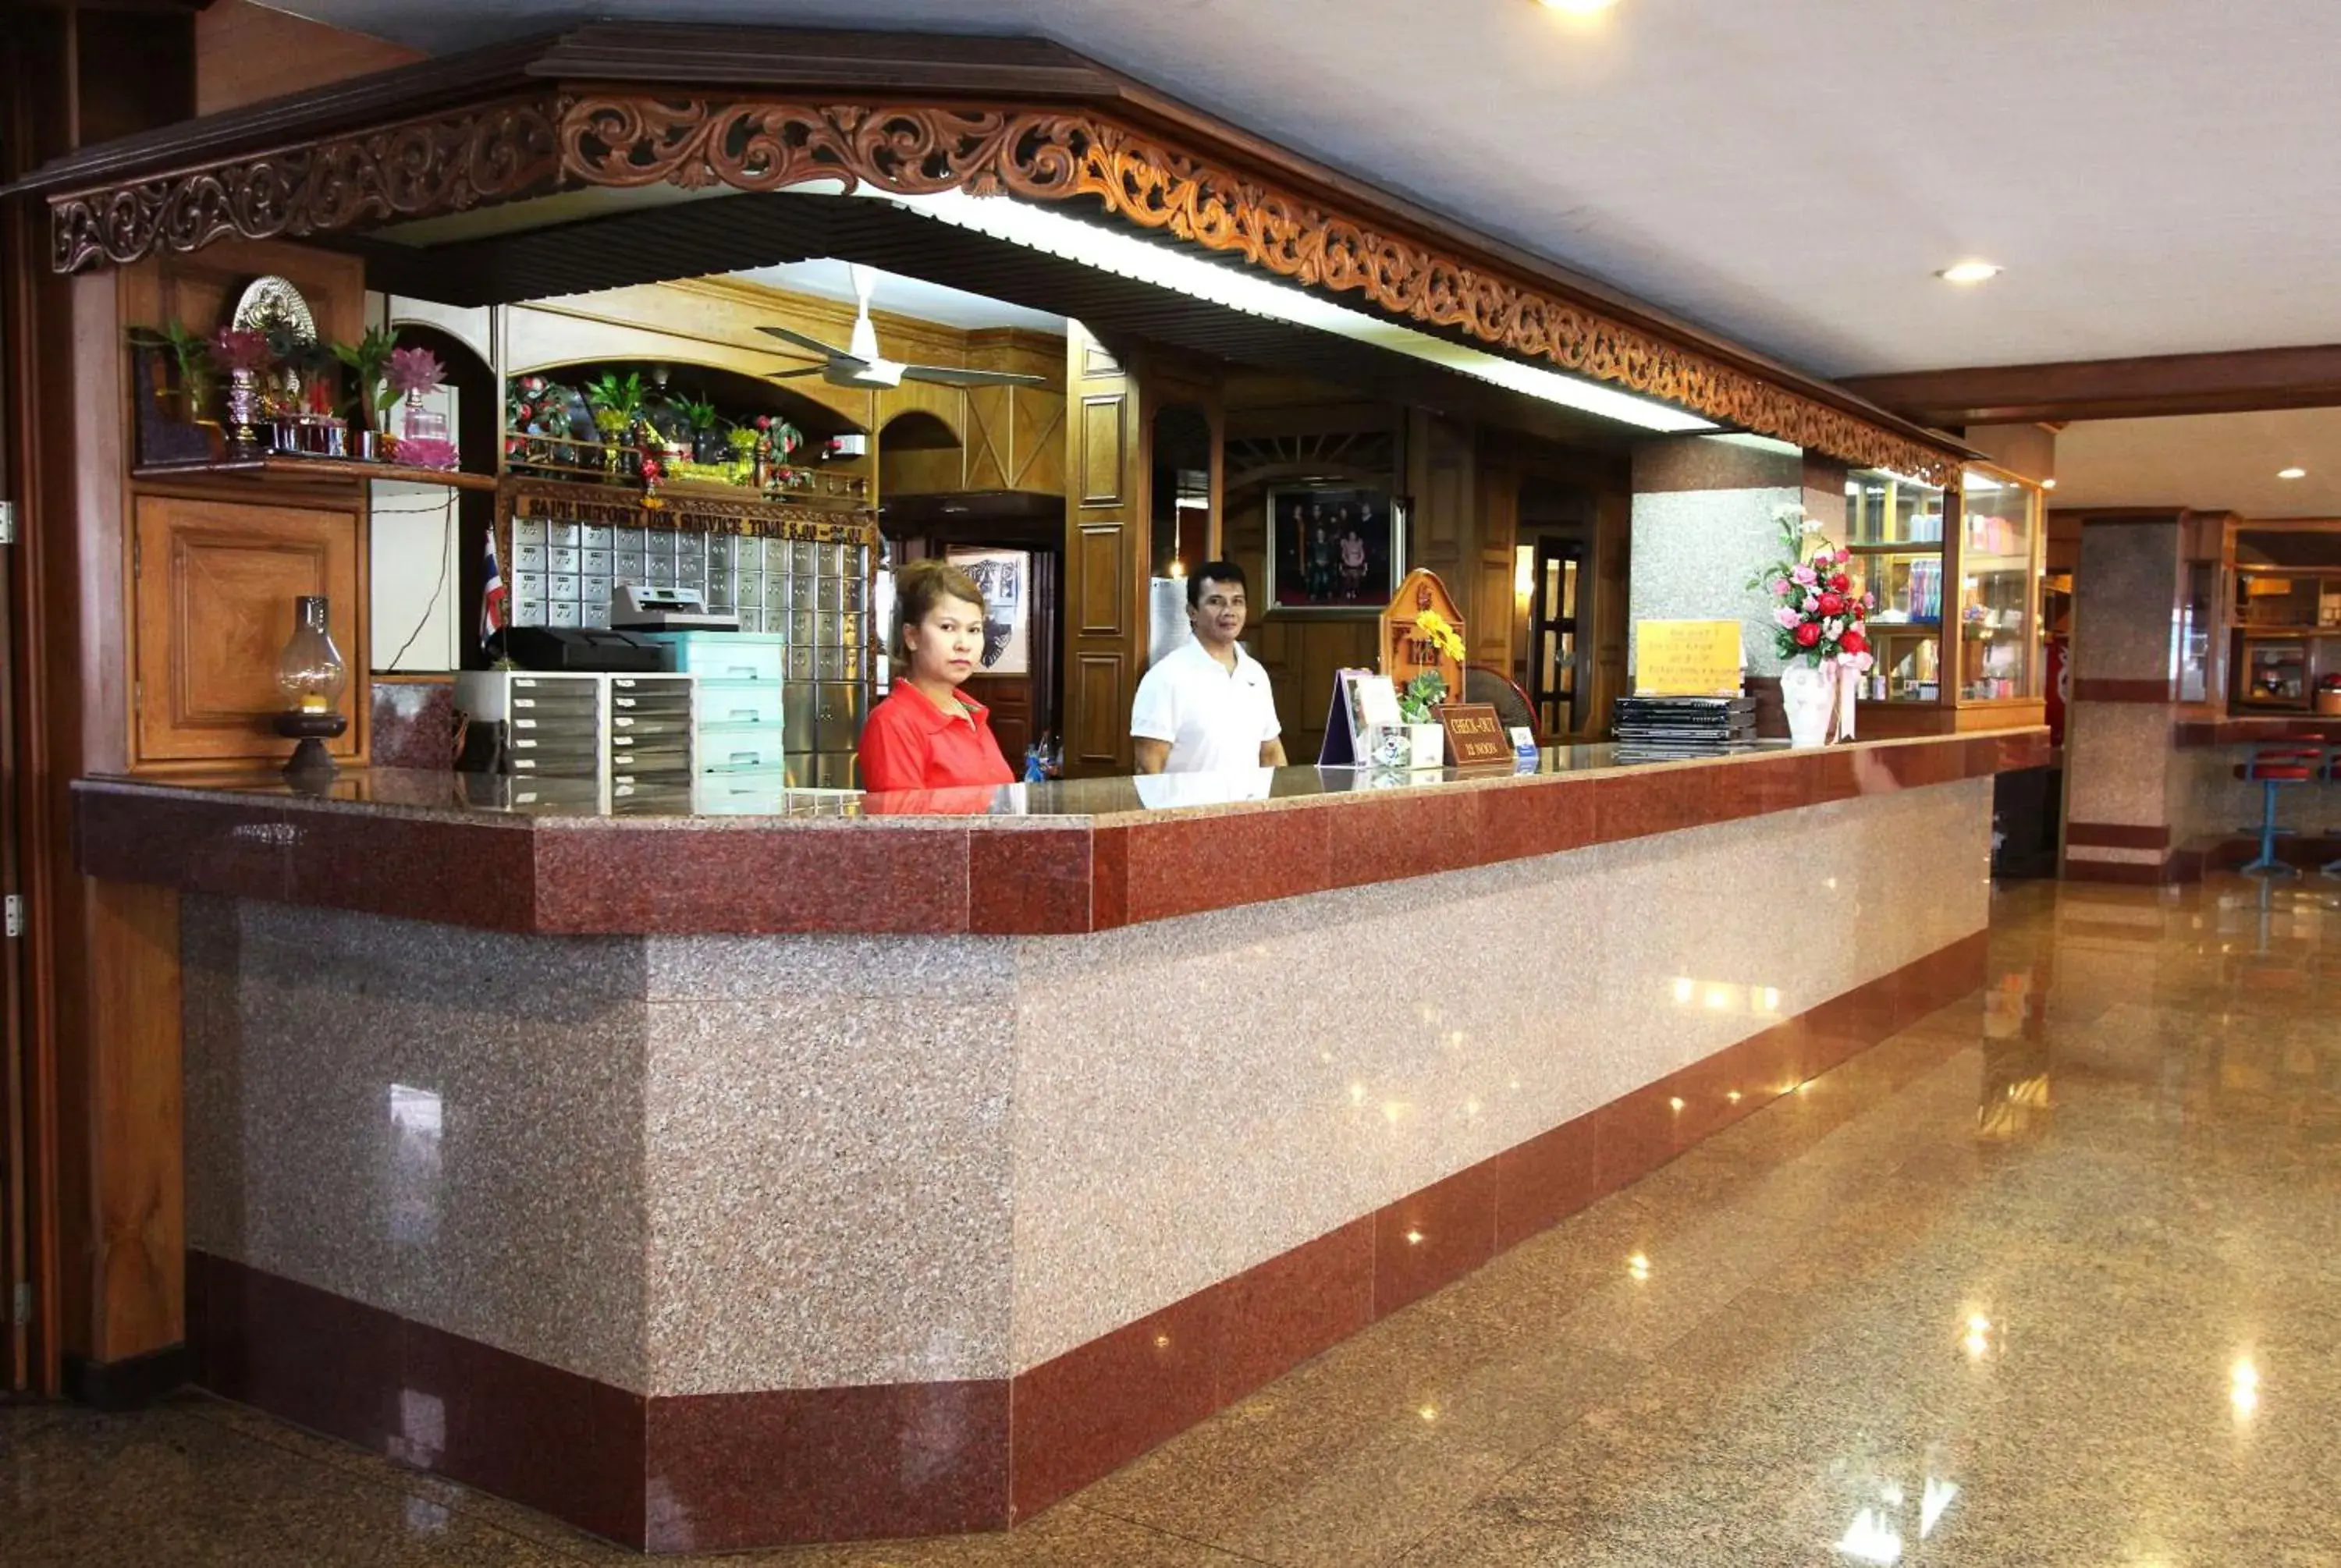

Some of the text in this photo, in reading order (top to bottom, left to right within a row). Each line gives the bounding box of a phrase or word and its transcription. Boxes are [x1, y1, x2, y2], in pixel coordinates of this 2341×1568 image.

[679, 513, 741, 535] SERVICE
[749, 519, 783, 538] TIME
[1451, 718, 1496, 734] CHECK-OUT
[1474, 742, 1498, 755] NOON
